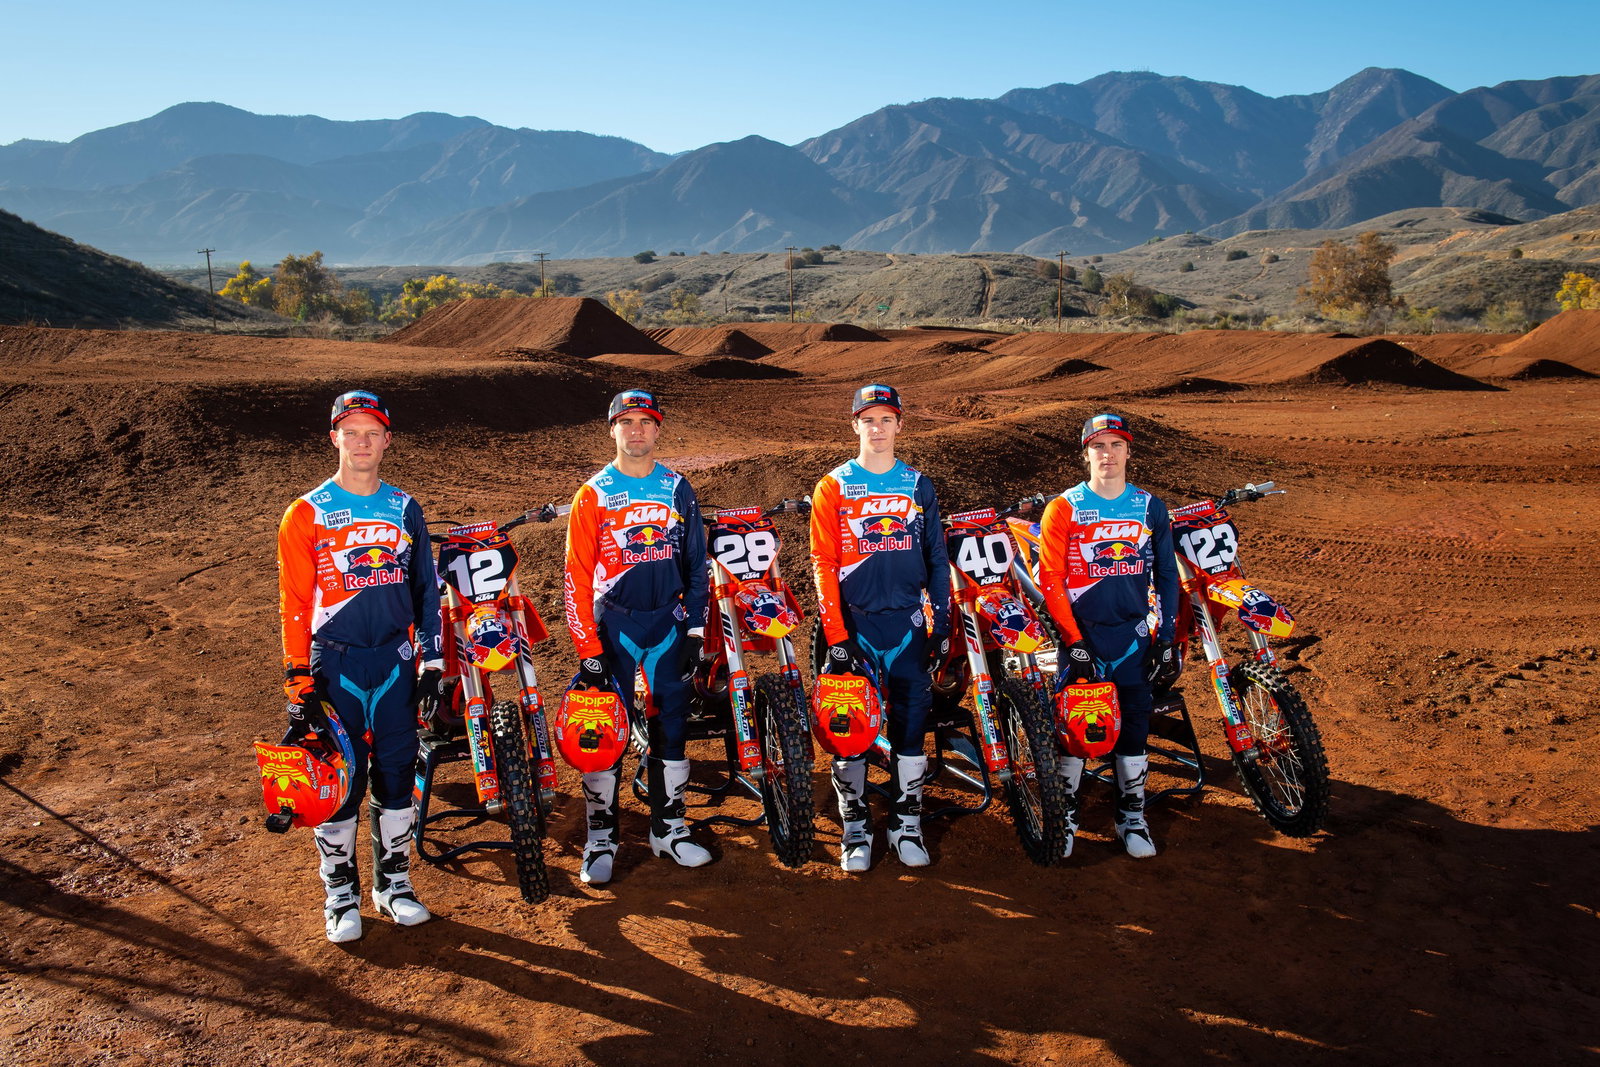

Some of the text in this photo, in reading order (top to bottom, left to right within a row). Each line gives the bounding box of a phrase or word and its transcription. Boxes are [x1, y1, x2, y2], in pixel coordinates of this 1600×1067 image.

[314, 492, 331, 503] PPG
[607, 492, 628, 501] nature's
[847, 489, 866, 497] bakery
[608, 498, 628, 508] bakery
[861, 497, 908, 515] KTM
[327, 510, 350, 519] nature's
[624, 505, 667, 525] KTM
[719, 508, 759, 517] ENTHAL
[328, 516, 350, 526] bakery
[345, 525, 398, 546] KTM
[451, 525, 495, 535] RENTHAL
[1092, 522, 1139, 540] KTM
[860, 535, 912, 552] Red Bull
[1179, 523, 1238, 569] 123
[623, 545, 673, 564] Red Bull
[713, 531, 776, 574] 28
[956, 532, 1013, 578] 40
[447, 549, 507, 597] 12
[1089, 560, 1144, 577] Red Bull
[1211, 564, 1228, 574] KTM
[345, 568, 403, 589] Red Bull
[742, 571, 760, 580] KTM
[980, 575, 1001, 586] KTM
[475, 592, 495, 602] KTM
[820, 677, 865, 690] adidas
[1068, 685, 1112, 698] adidas
[569, 693, 615, 707] adidas
[255, 744, 303, 762] adidas
